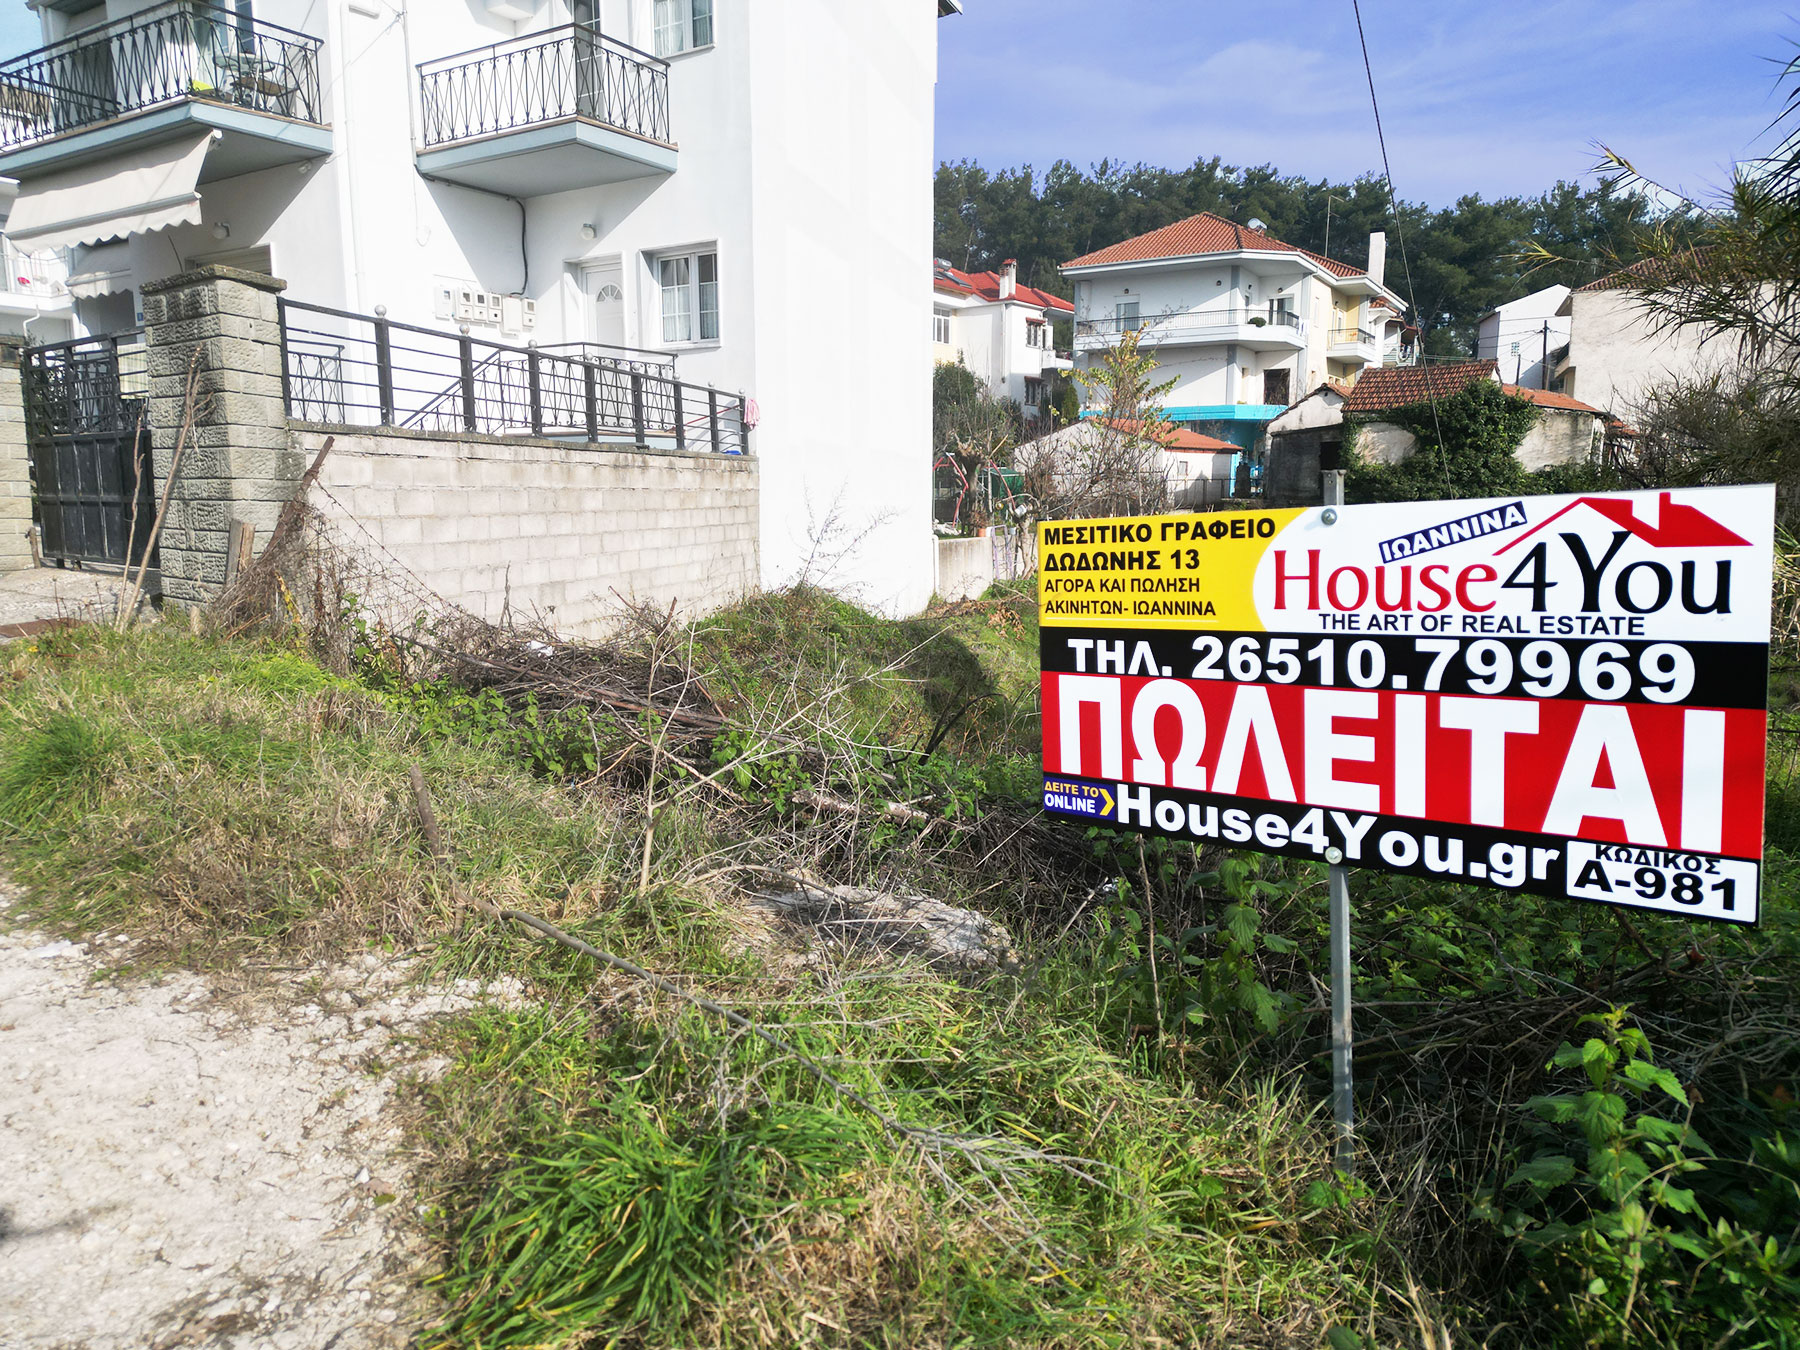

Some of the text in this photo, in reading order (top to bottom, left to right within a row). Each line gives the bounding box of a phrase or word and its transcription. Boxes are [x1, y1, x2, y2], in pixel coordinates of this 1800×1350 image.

[1044, 518, 1276, 545] ΜΕΣΙΤΙΚΟ ΓΡΑΦΕΙΟ
[1382, 505, 1526, 562] ΙΩΑΝΝΙΝΑ
[1044, 549, 1200, 571] ΔΩΔΩΝΗΣ 13
[1273, 531, 1732, 615] House4You
[1044, 578, 1200, 592] ΑΓΟΡΑ ΚΑΙ ΠΩΛΗΣΗ
[1133, 601, 1216, 616] ΙΩΑΝΝΙΝΑ
[1318, 613, 1645, 636] THE ART OF REAL ESTATE
[1067, 636, 1696, 704] ΤΗΛ. 26510.79969
[1058, 674, 1726, 853] ΠΩΛΕΙΤΑΙ
[1044, 781, 1099, 798] ΔΕΙΤΕ ΤΟ
[1044, 793, 1096, 813] ONLINE
[1117, 783, 1560, 888] House4You.gr
[1595, 844, 1721, 875] ΚΩΔΙΚΟΣ
